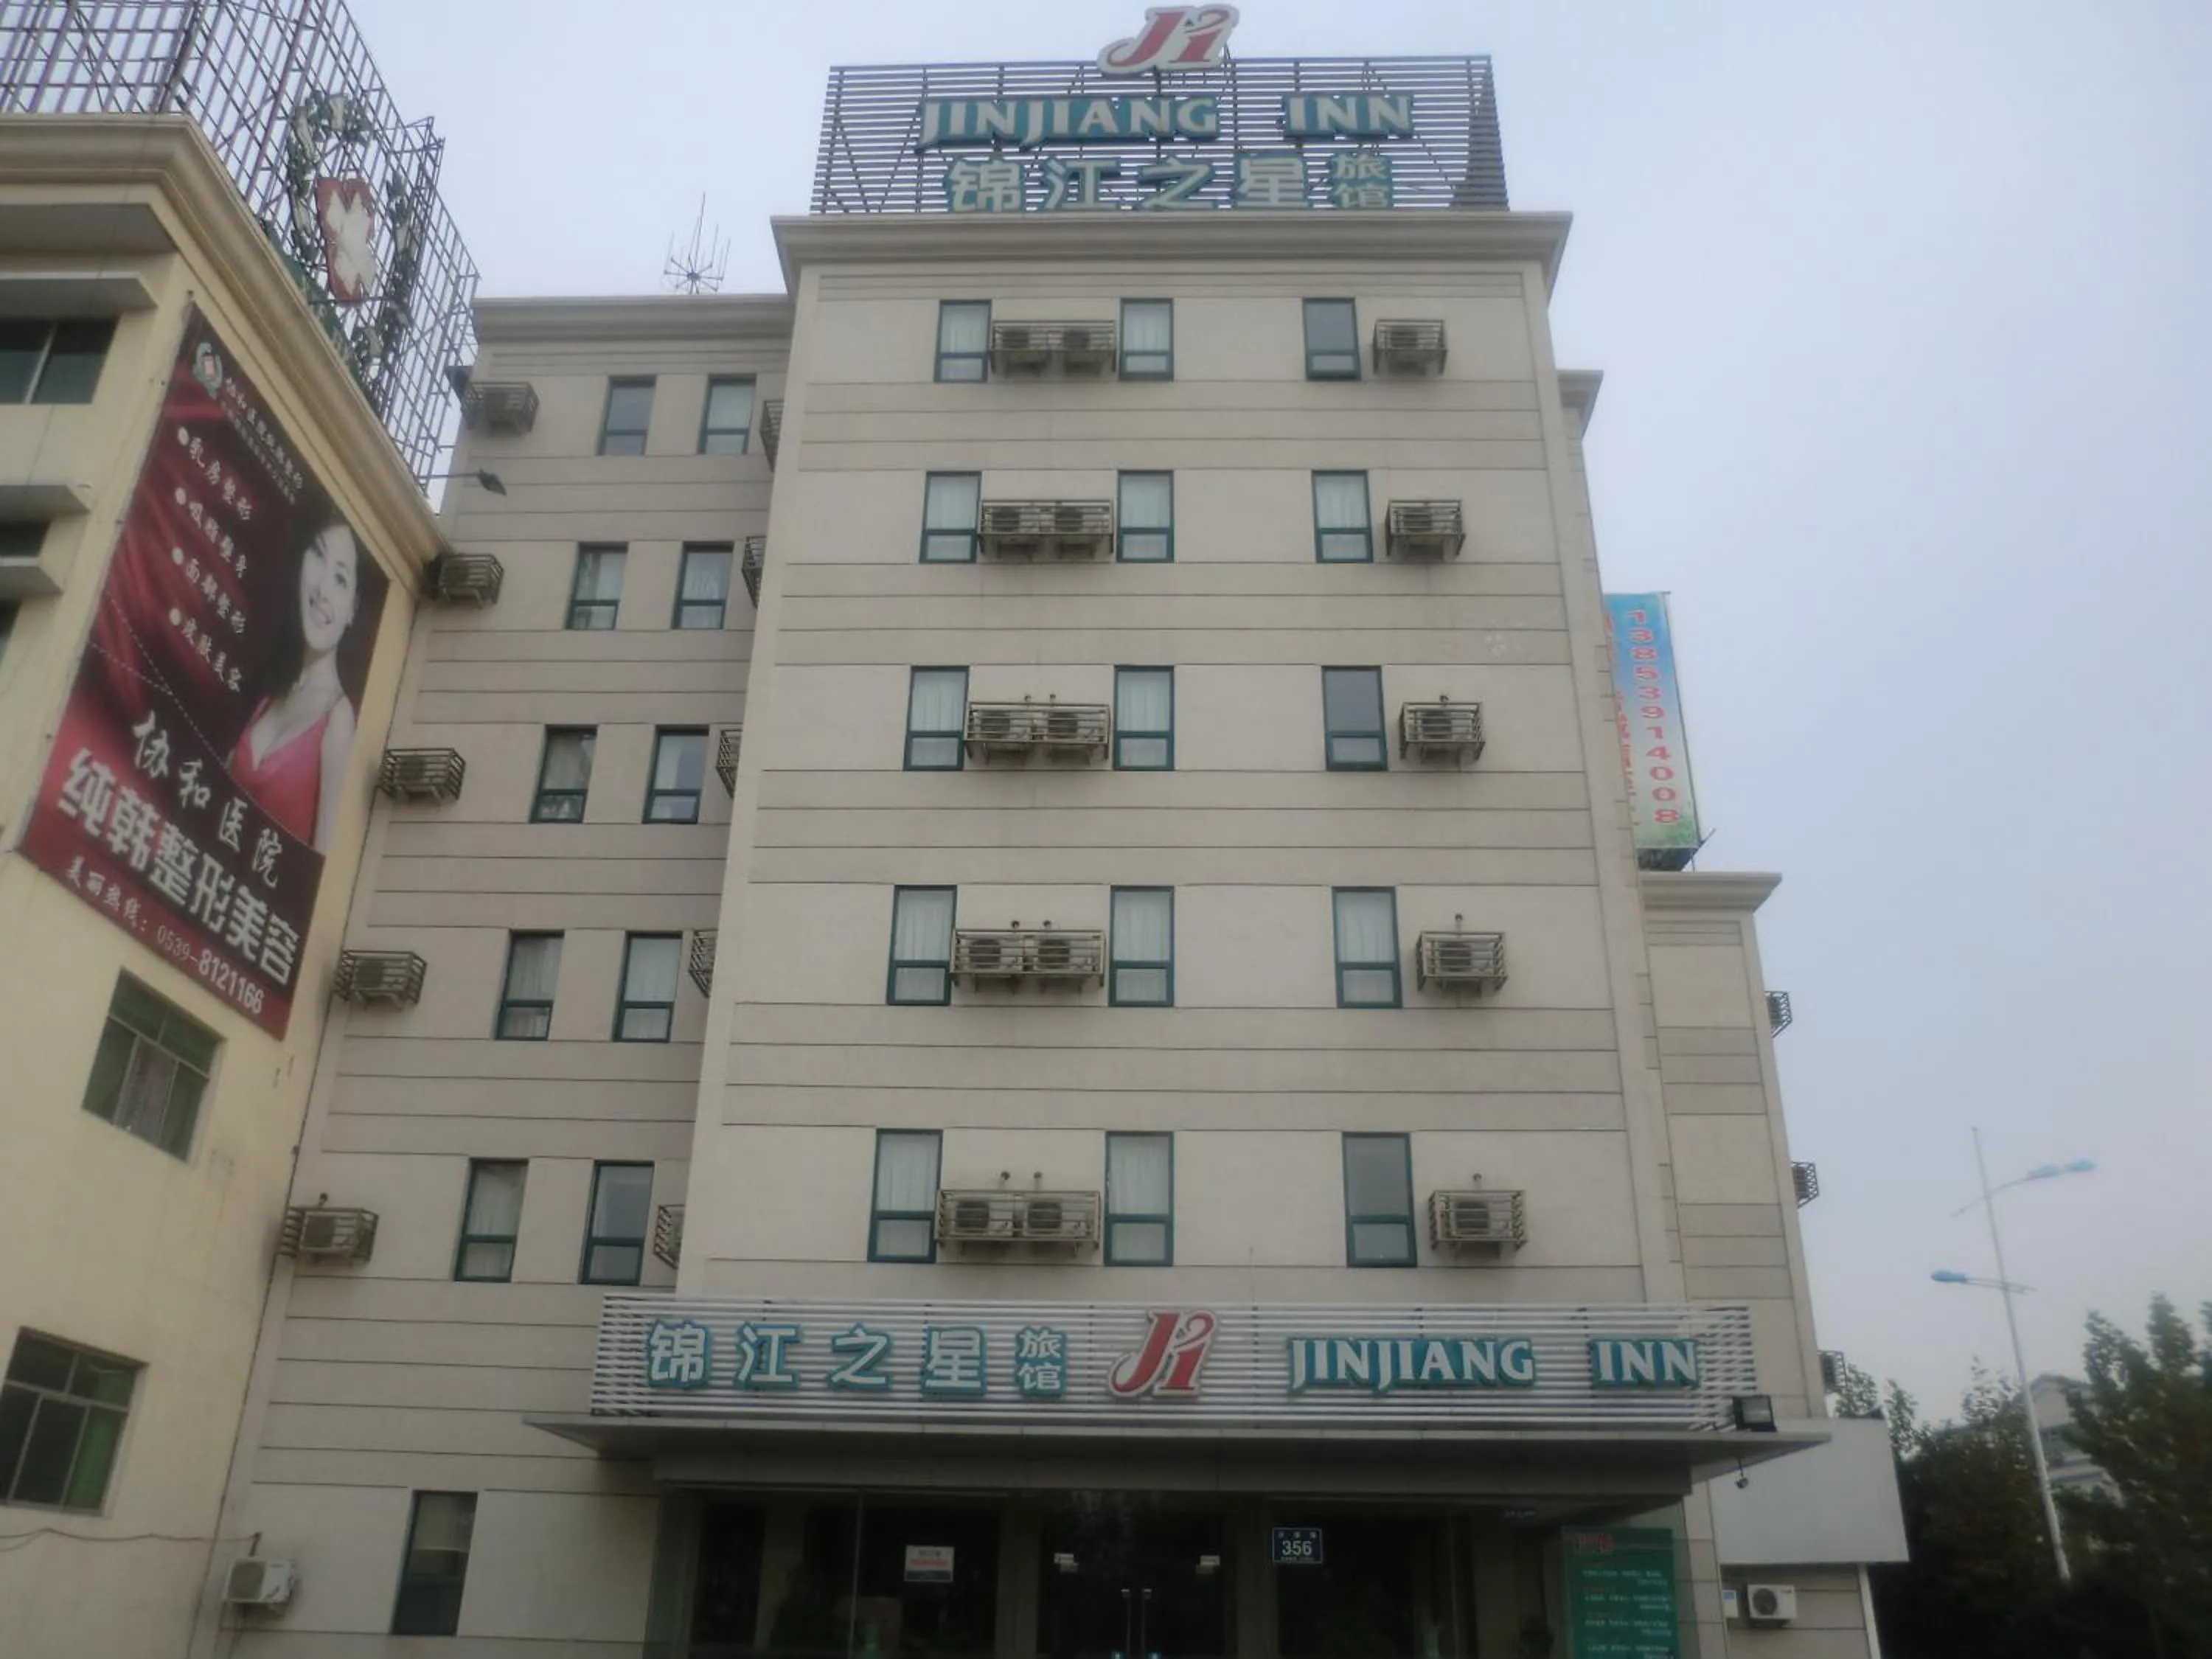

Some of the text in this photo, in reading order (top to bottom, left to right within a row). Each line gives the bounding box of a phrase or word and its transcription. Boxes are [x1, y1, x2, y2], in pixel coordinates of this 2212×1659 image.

[919, 96, 1411, 147] JINJIANG INN
[948, 156, 1389, 212] 锦江之星 旅馆
[133, 709, 283, 888] 协和医院
[58, 746, 299, 987] 纯韩整形美容
[649, 1325, 1062, 1391] 锦江之星 旅馆
[1289, 1339, 1697, 1388] JINJIANG INN
[1281, 1540, 1312, 1556] 356
